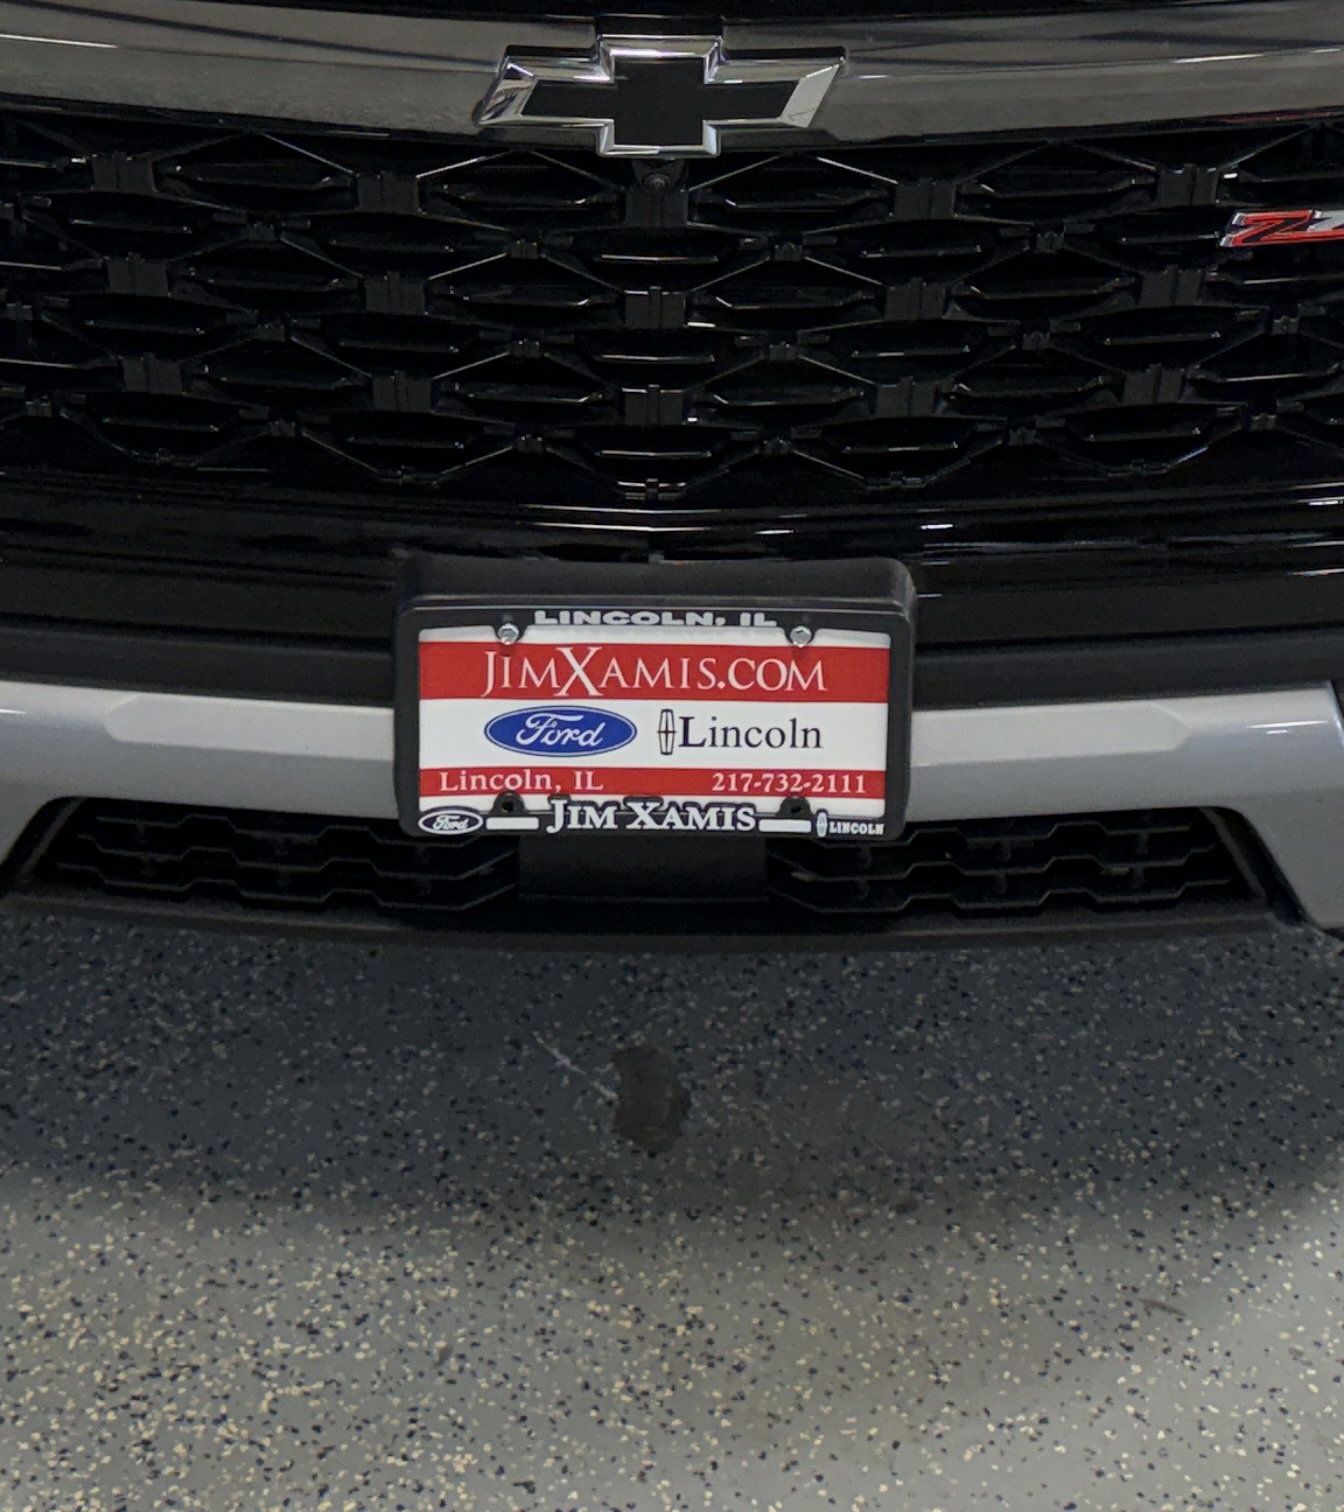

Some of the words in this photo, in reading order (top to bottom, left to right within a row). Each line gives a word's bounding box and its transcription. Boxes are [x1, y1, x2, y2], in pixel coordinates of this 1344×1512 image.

[534, 610, 726, 628] LINCOLN,
[739, 611, 777, 628] IL
[515, 713, 606, 748] Ford
[678, 716, 823, 750] Lincoln
[439, 769, 562, 794] Lincoln,
[574, 770, 604, 791] IL
[711, 772, 865, 794] 217-732-2111
[432, 814, 469, 831] Ford
[546, 799, 617, 833] JIM
[625, 801, 756, 831] XAMIS
[828, 820, 885, 836] LINCOLN
